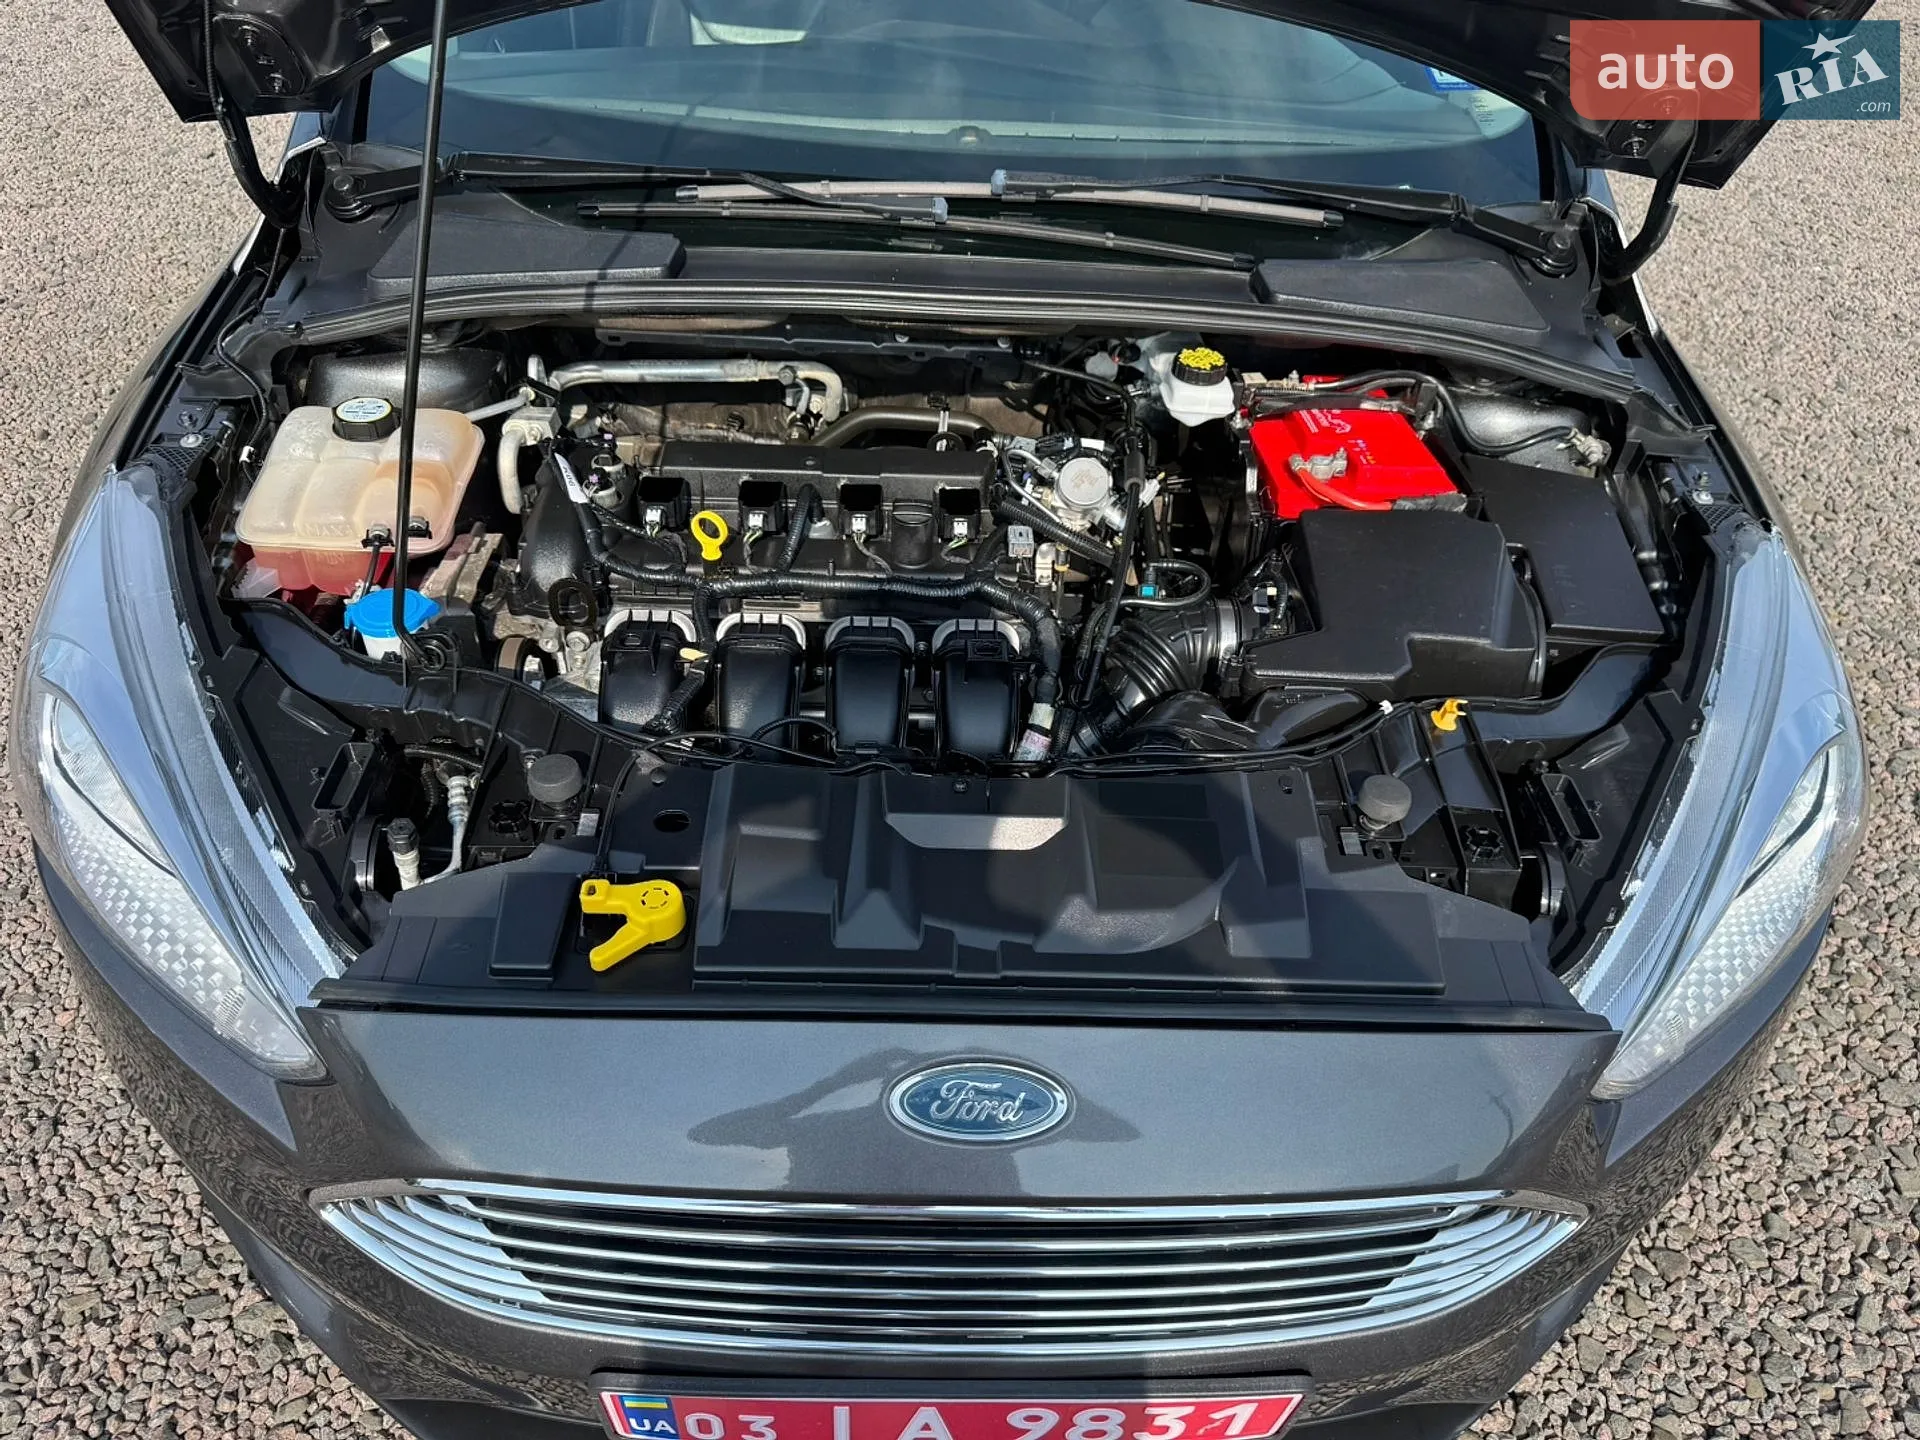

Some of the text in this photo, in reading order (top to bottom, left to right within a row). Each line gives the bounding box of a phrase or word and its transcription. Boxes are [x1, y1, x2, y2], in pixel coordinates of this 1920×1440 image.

[930, 1079, 1026, 1123] Ford
[629, 1417, 678, 1435] UA
[685, 1412, 777, 1440] 03
[1006, 1402, 1259, 1440] 9831
